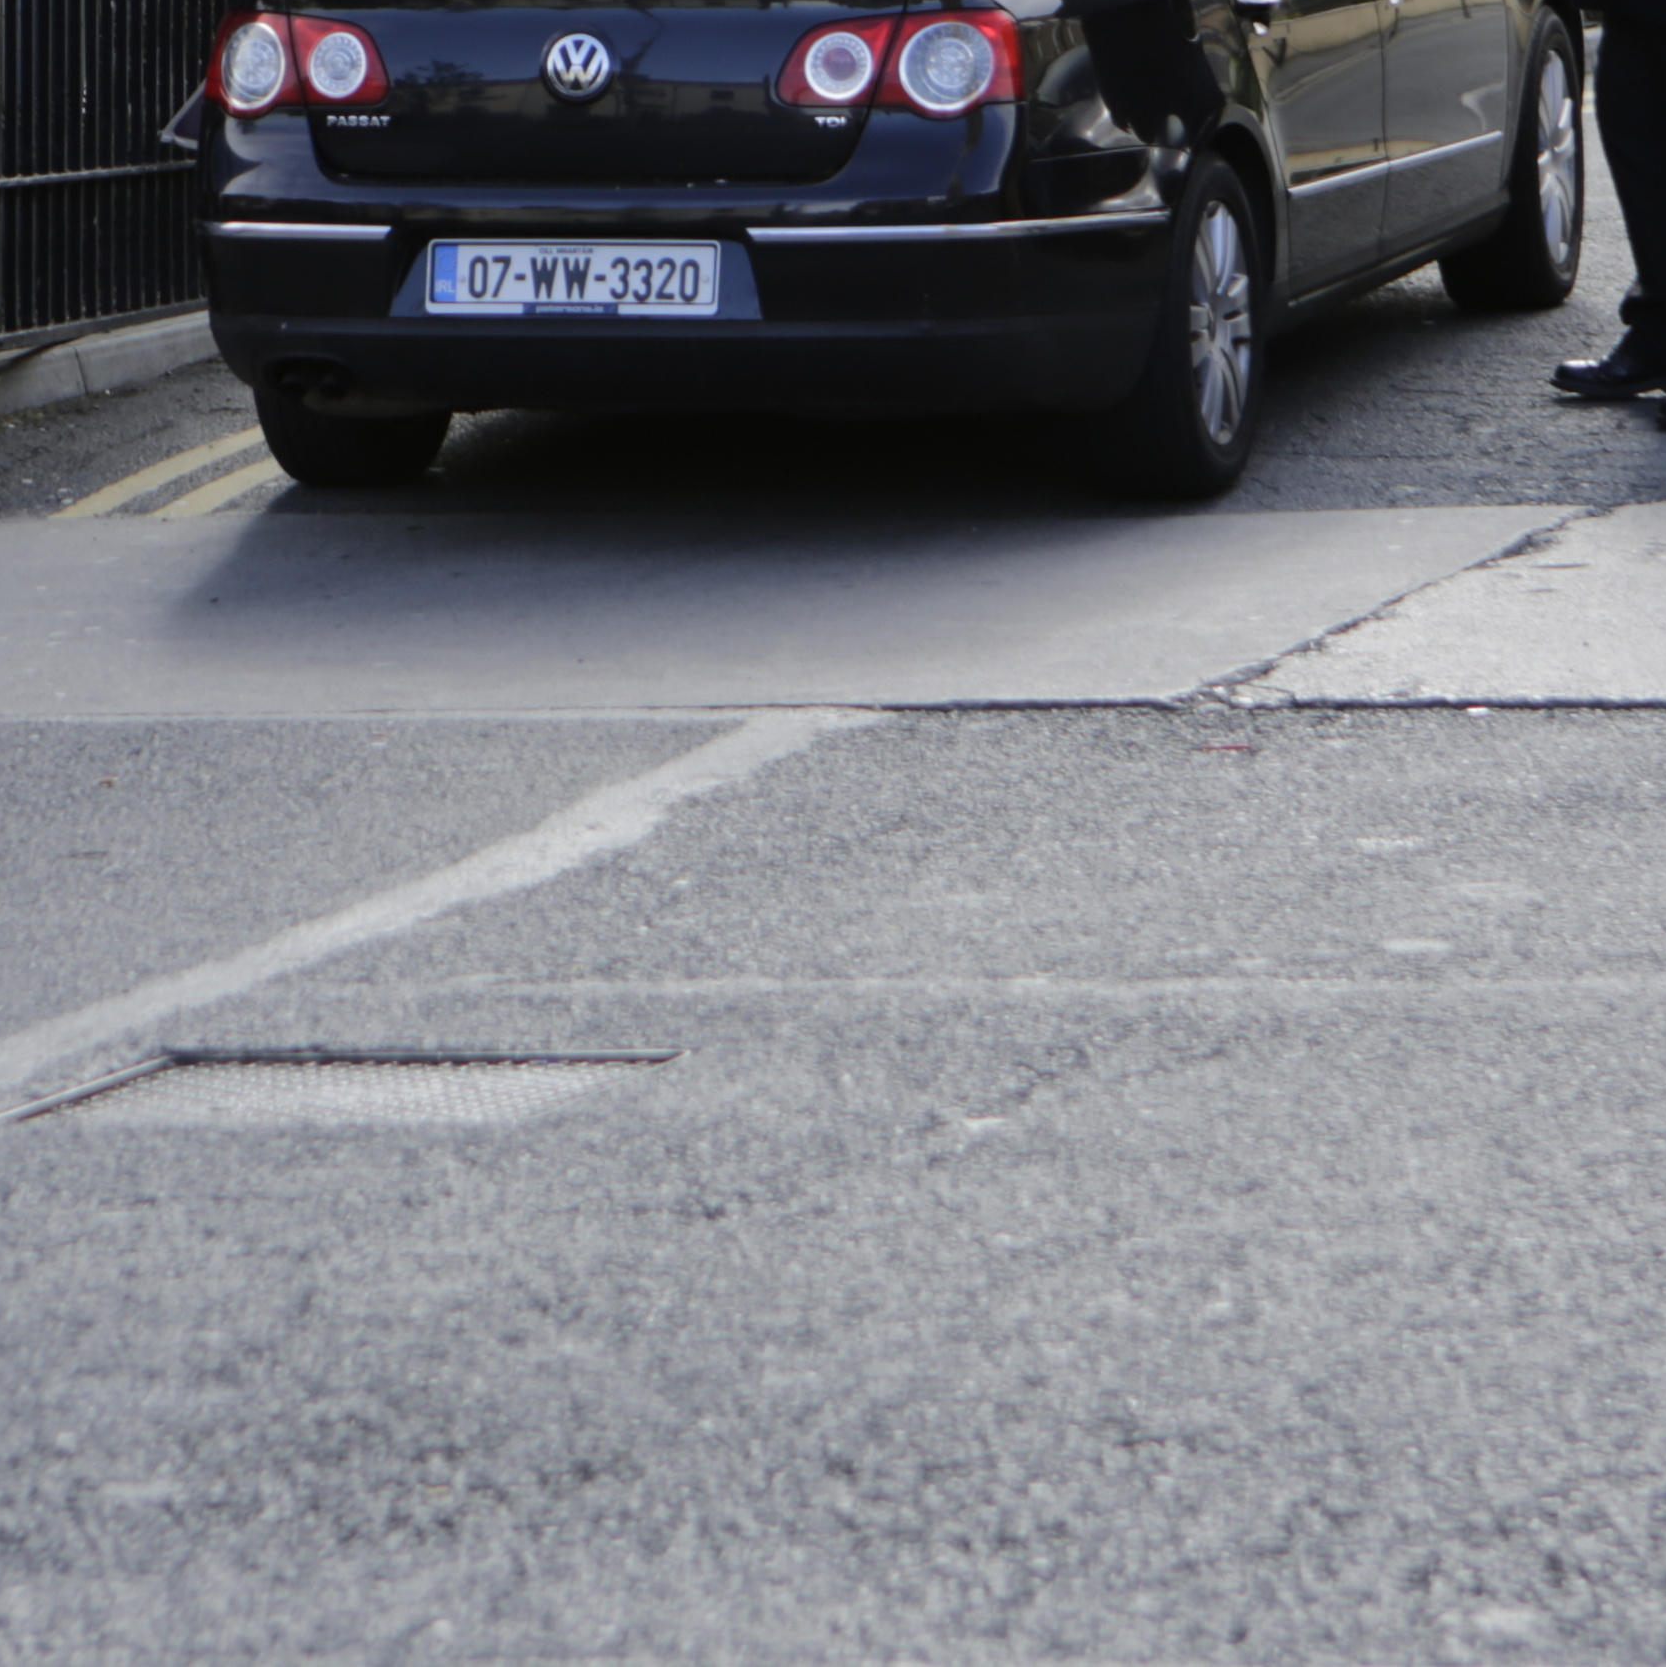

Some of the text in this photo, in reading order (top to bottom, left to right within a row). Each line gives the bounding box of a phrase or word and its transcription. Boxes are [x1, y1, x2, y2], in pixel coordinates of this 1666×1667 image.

[326, 115, 391, 128] PASSAT
[814, 116, 849, 129] TDI
[468, 255, 701, 303] 07-WW-3320
[434, 279, 455, 294] IRL
